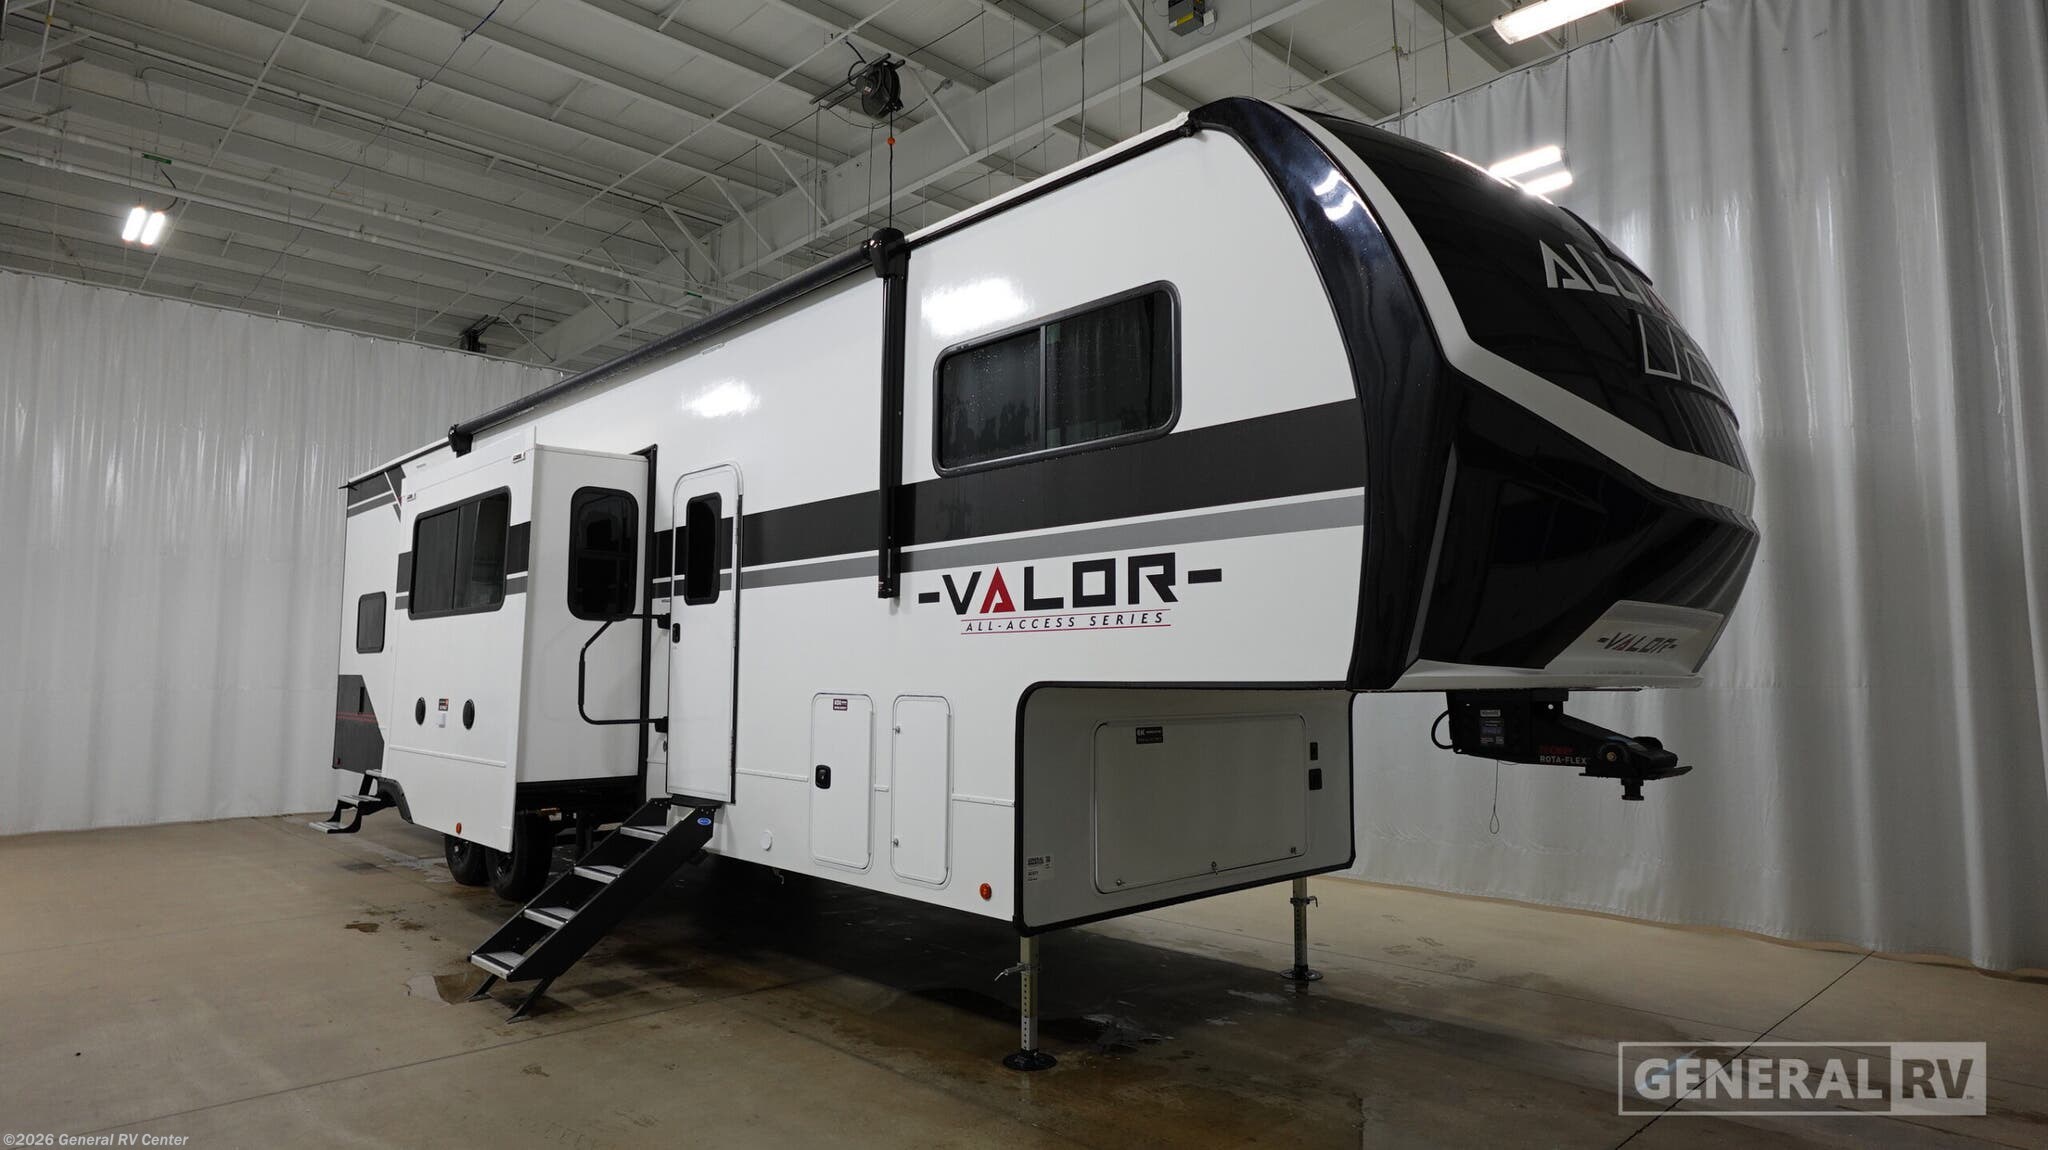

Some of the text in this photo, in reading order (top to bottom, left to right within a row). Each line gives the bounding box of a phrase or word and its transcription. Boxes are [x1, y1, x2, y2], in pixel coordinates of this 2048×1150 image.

[965, 611, 1164, 632] ALL-ACCESS SERIES
[1540, 755, 1587, 765] ROTA-FLEX
